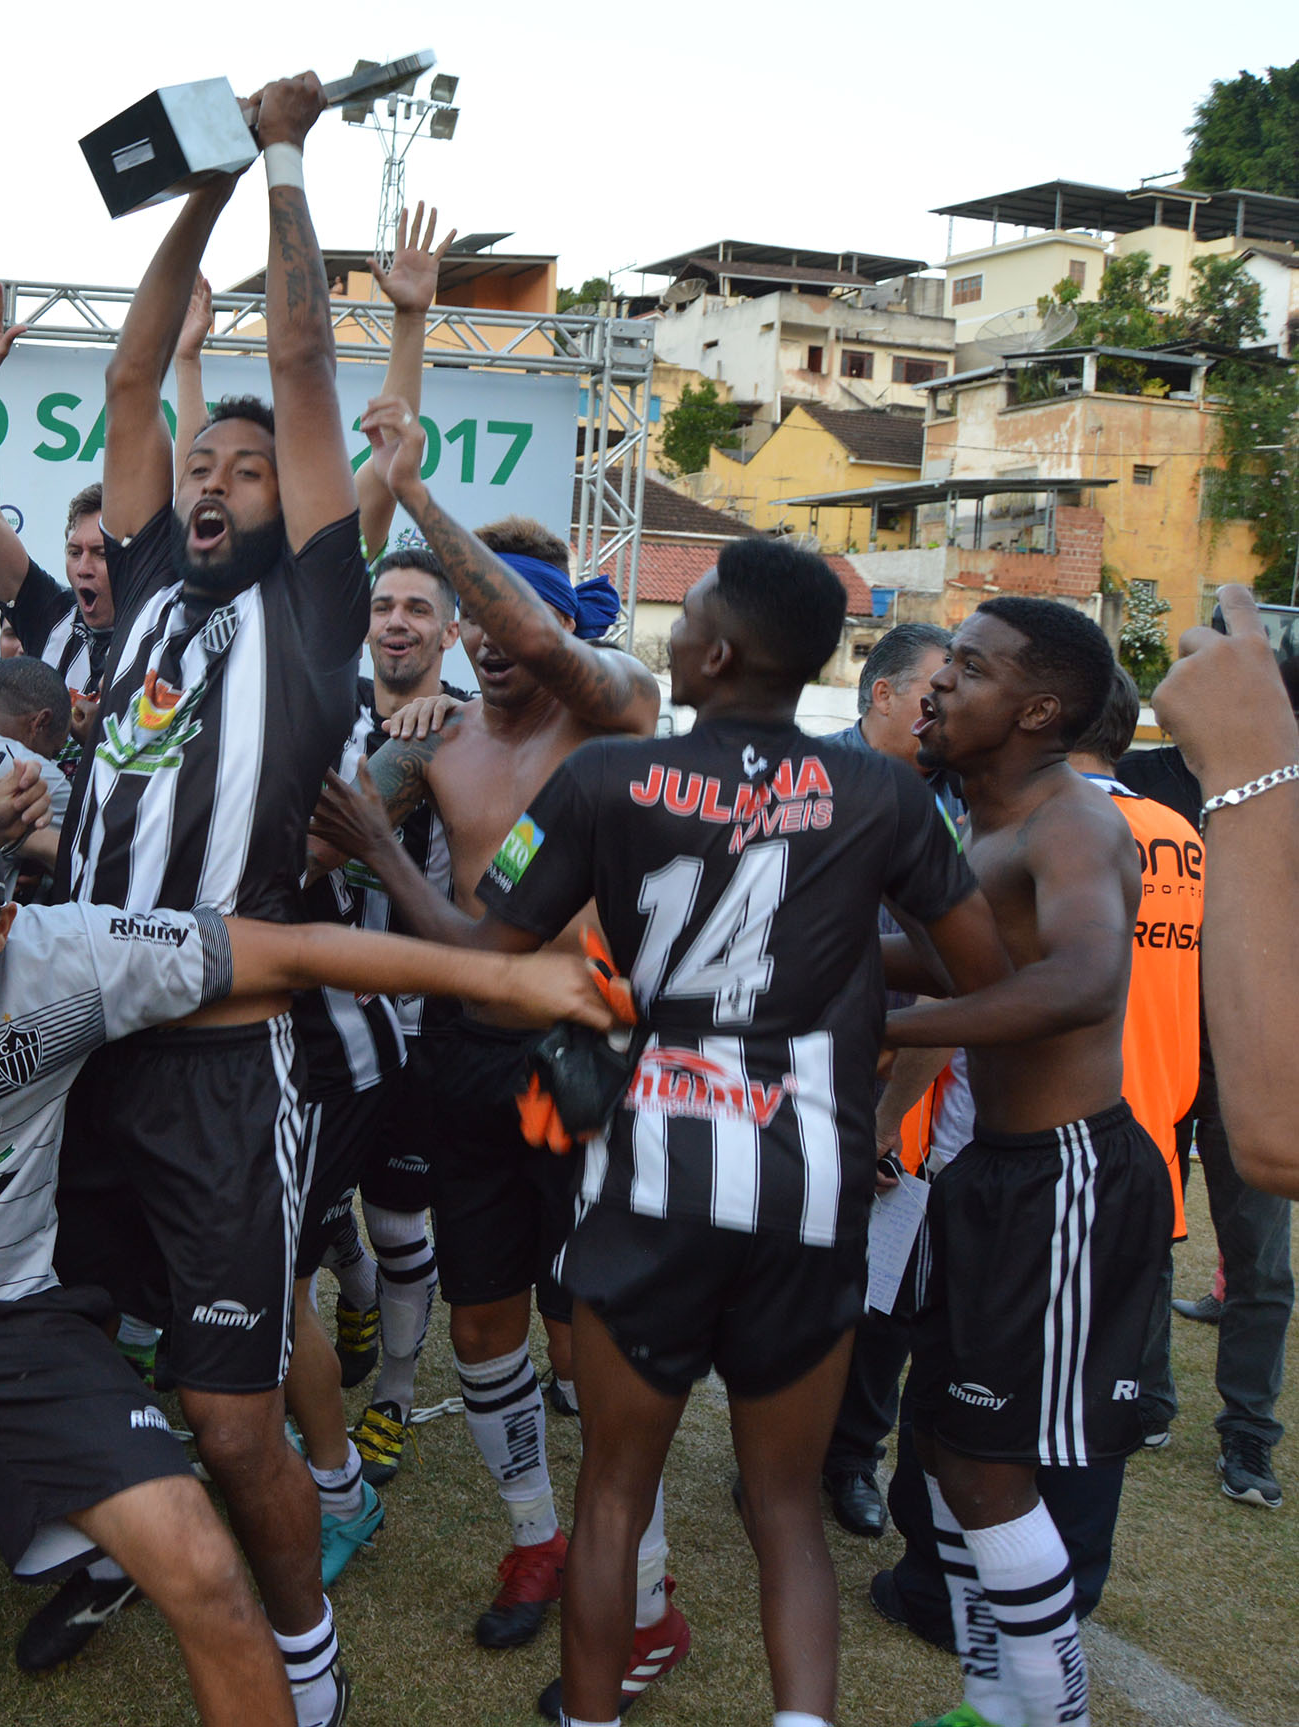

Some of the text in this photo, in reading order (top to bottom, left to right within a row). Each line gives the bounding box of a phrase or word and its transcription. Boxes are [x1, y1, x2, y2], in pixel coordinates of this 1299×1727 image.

[109, 917, 190, 948] Rhumy
[629, 838, 789, 1028] 14
[0, 1031, 33, 1056] CAI
[387, 1156, 431, 1174] Rhumy
[192, 1304, 262, 1330] Rhumy
[948, 1381, 1007, 1411] Rhumy
[500, 1404, 542, 1481] Rhumy
[1052, 1630, 1088, 1724] Rhumy
